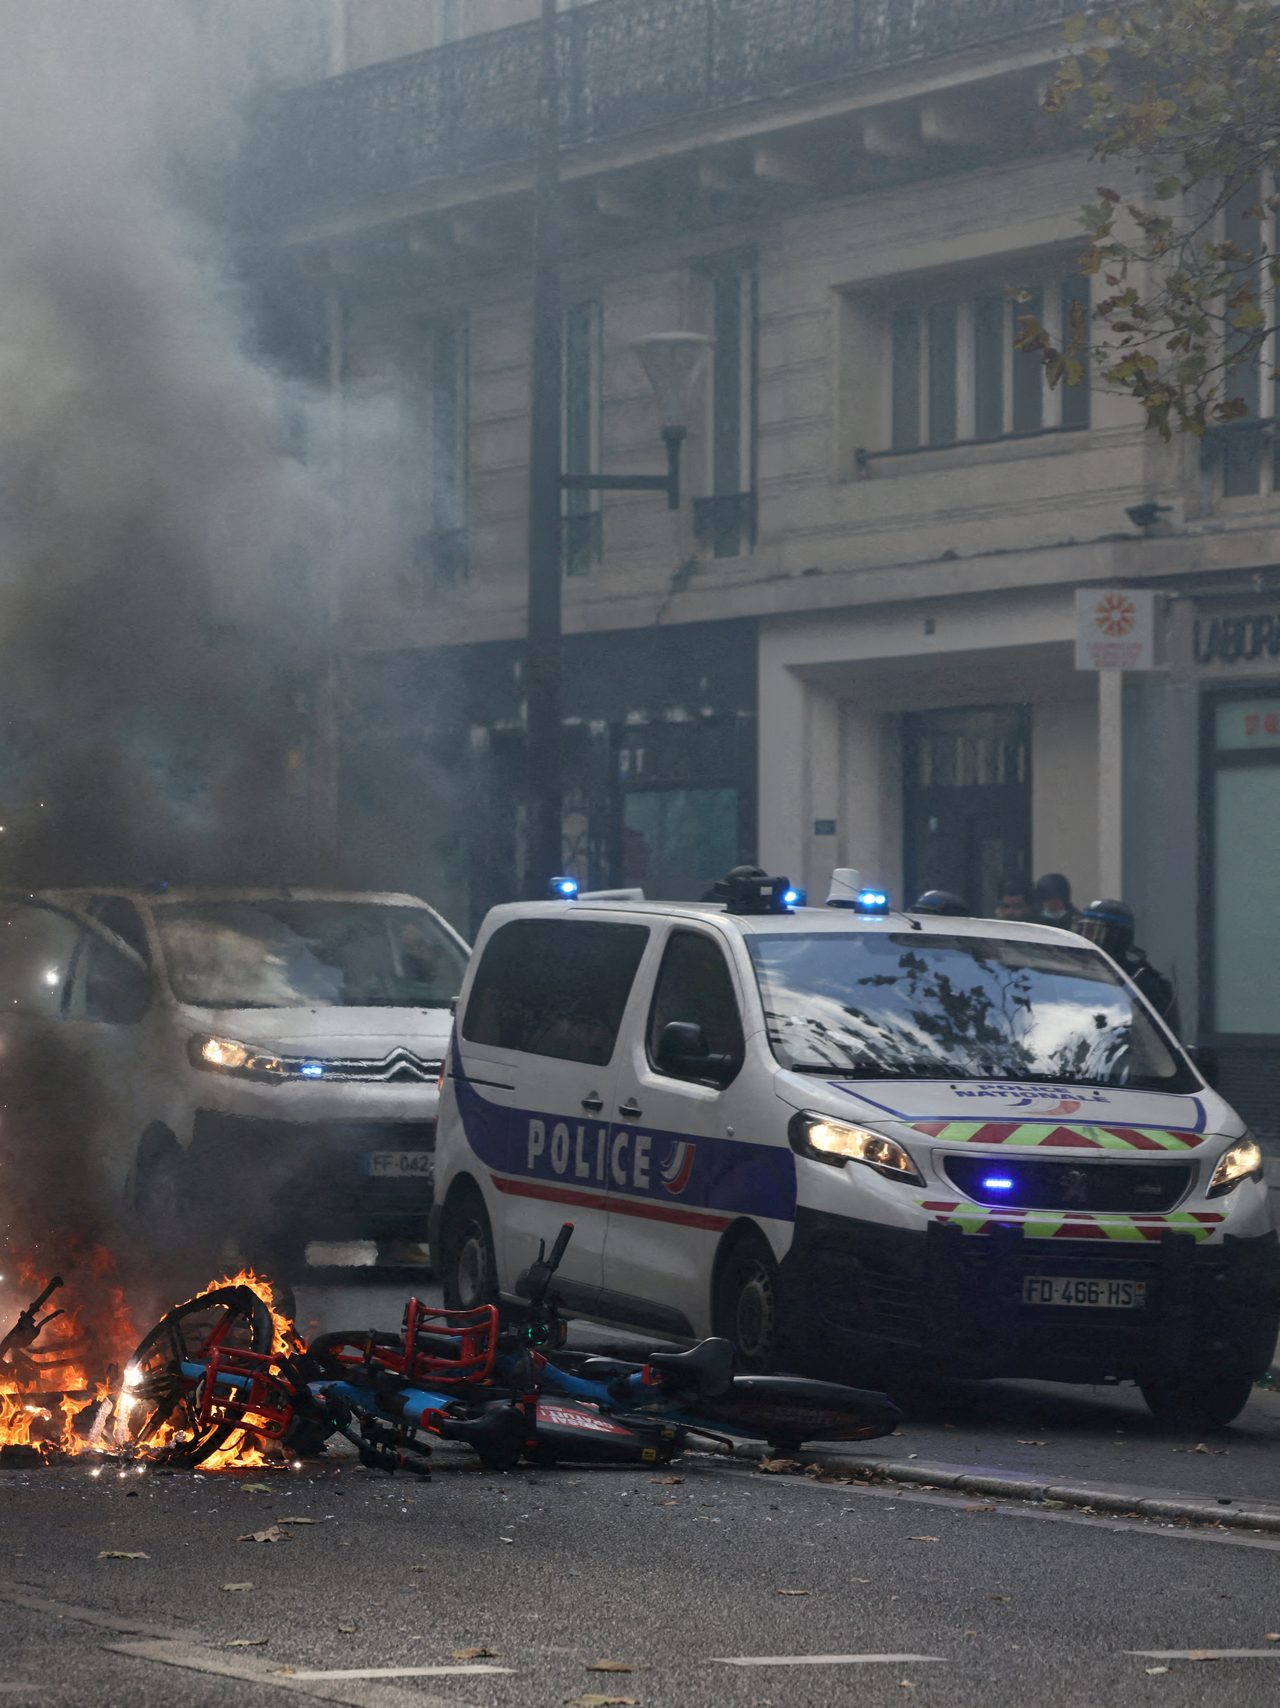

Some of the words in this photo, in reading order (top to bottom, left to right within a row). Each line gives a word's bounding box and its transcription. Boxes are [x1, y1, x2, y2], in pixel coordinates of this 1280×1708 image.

[954, 1090, 1111, 1104] NATIONALE
[977, 1085, 1072, 1095] POLICE
[527, 1119, 652, 1189] POLICE
[1027, 1280, 1133, 1305] FD-466-HS
